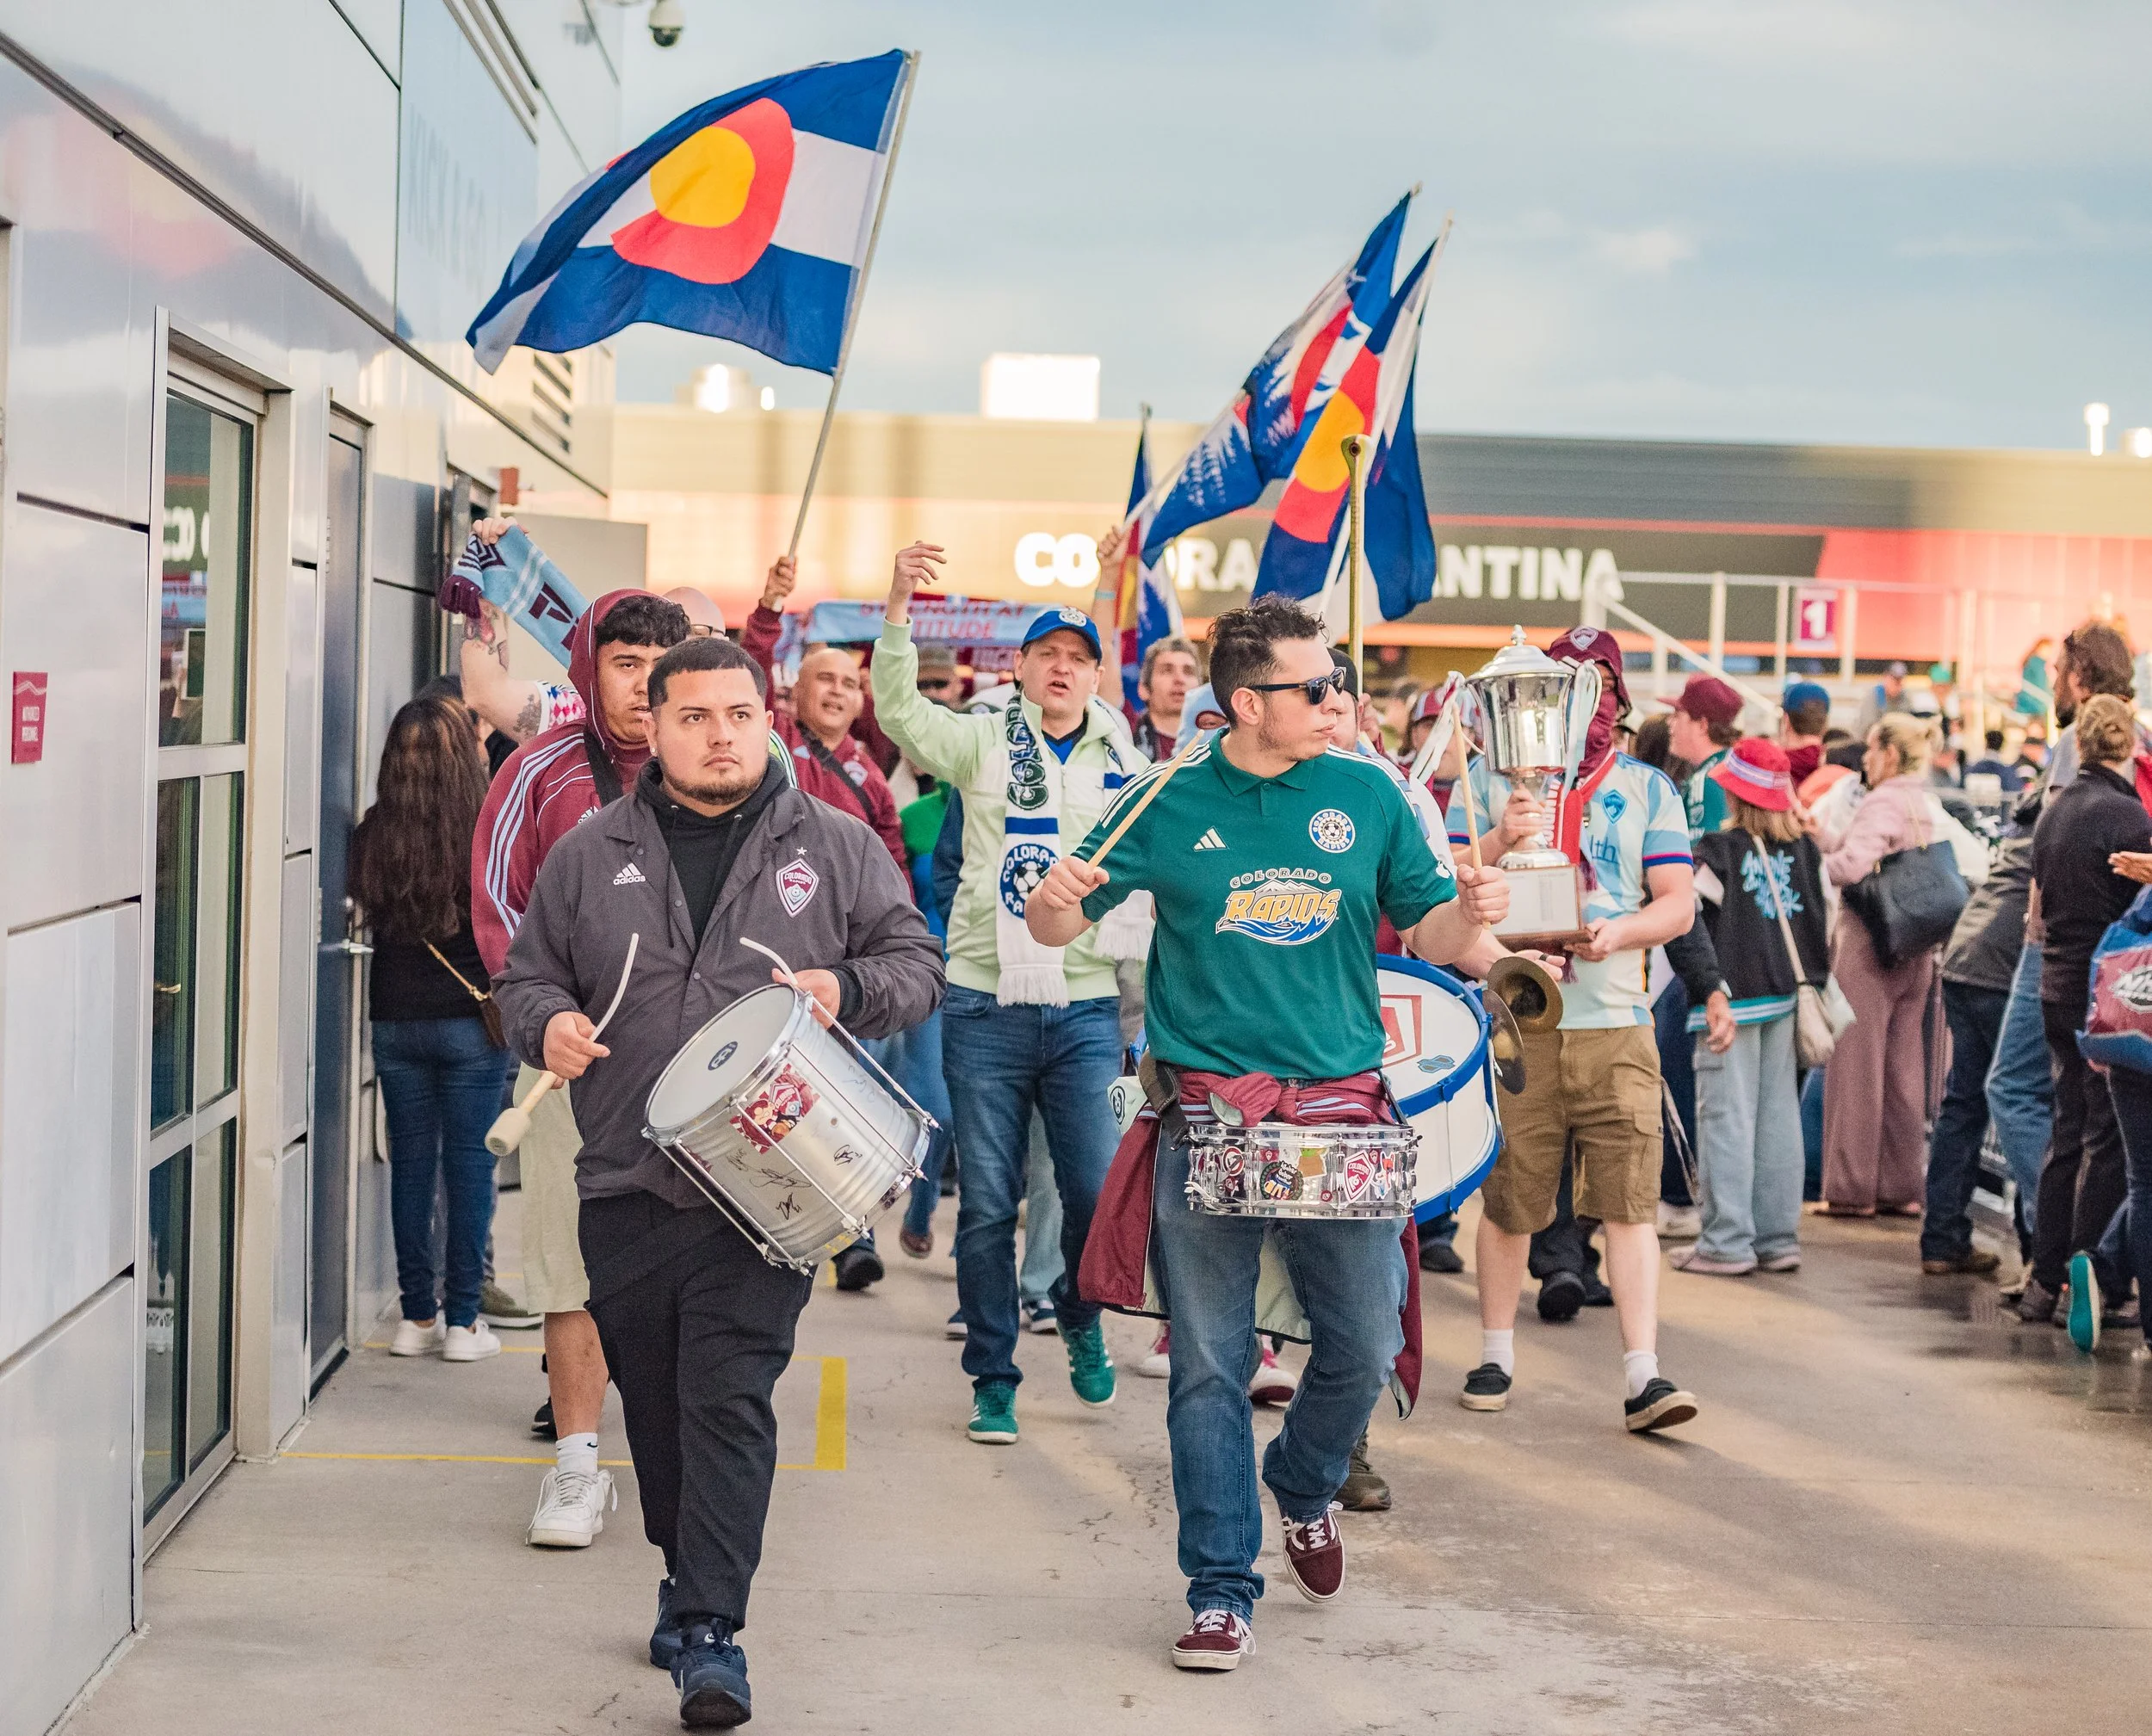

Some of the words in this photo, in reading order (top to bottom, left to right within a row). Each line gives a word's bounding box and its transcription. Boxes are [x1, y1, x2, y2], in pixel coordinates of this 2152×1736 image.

[1804, 601, 1826, 638] 1
[613, 874, 646, 886] adidas
[1003, 845, 1060, 883] COLORAD
[1229, 868, 1332, 888] COLORADO
[1227, 889, 1342, 924] RAPIDS
